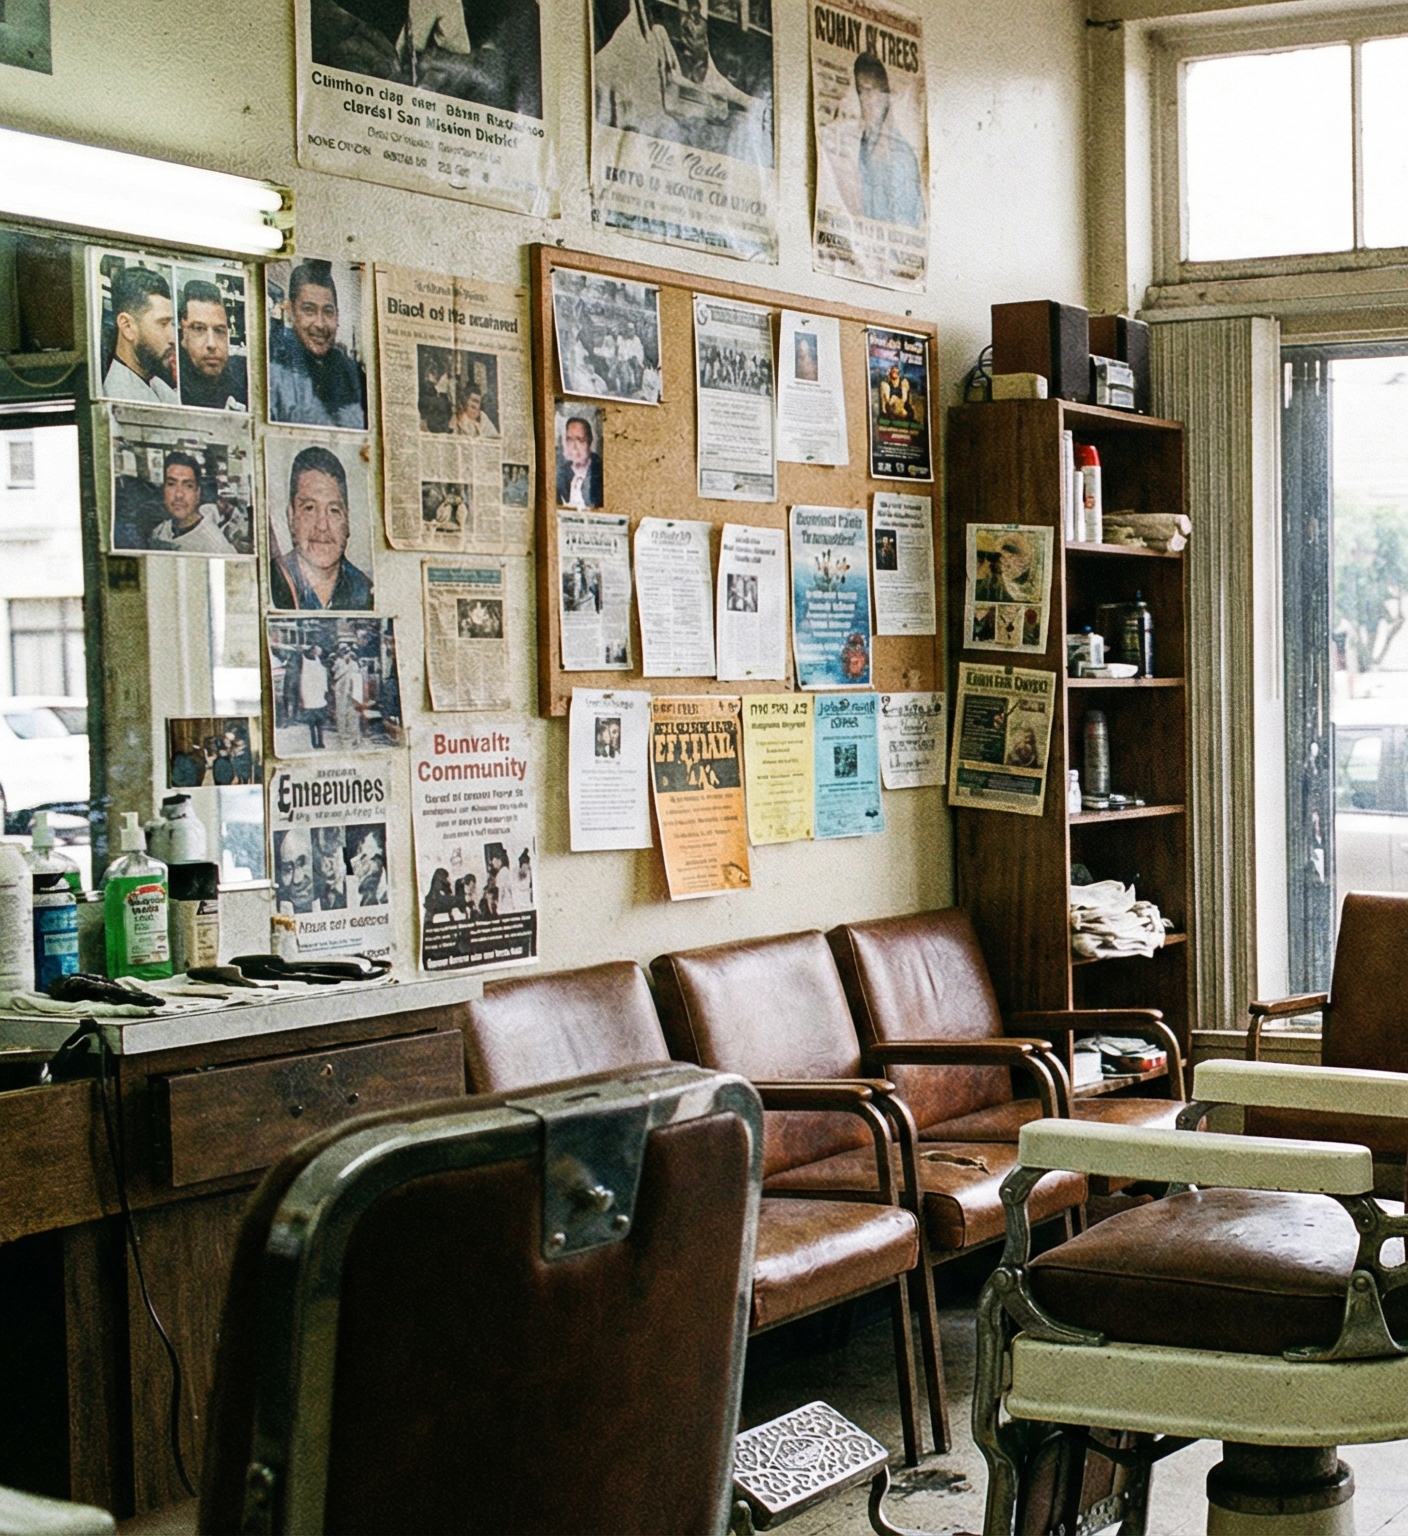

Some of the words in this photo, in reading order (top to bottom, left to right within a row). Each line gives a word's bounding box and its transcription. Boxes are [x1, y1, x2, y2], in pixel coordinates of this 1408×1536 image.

[879, 30, 919, 73] TREES
[397, 109, 421, 127] San
[418, 756, 527, 781] Community
